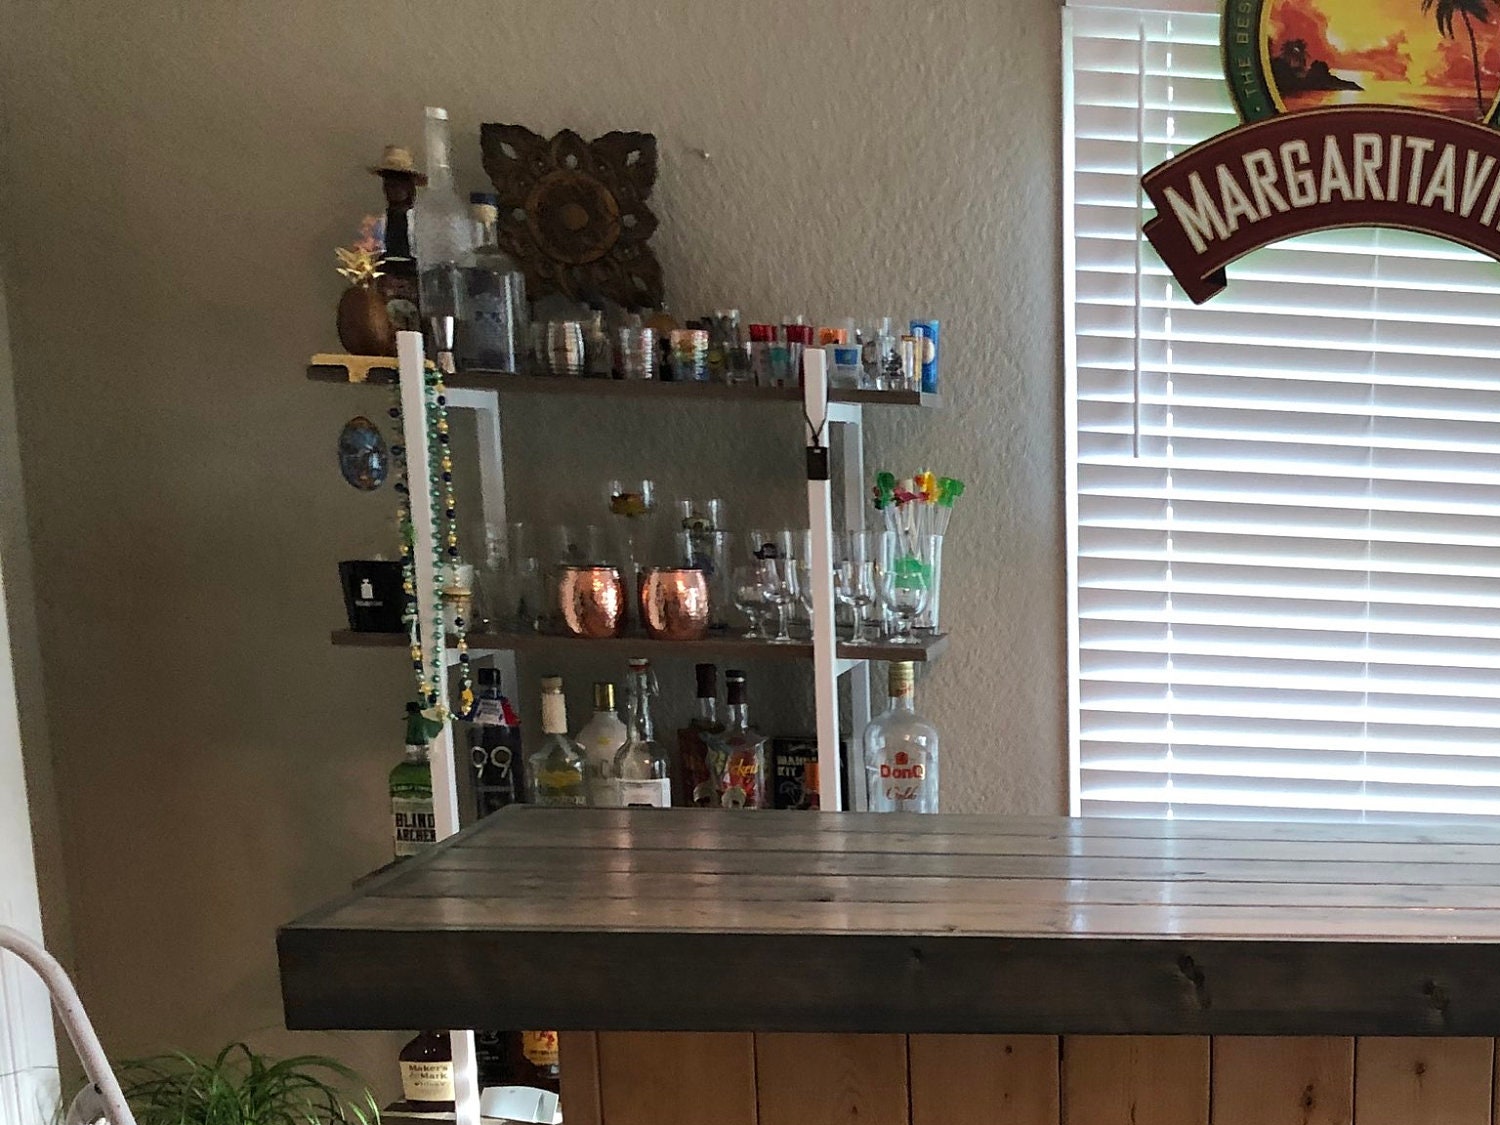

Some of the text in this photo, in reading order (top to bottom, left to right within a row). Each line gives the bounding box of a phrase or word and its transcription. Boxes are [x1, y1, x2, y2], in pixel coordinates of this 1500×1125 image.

[1239, 58, 1258, 98] THE
[472, 746, 513, 778] 99
[880, 764, 926, 780] DonQ
[395, 813, 435, 828] BLIND
[408, 1064, 449, 1073] Maker's
[420, 1072, 448, 1080] Mark
